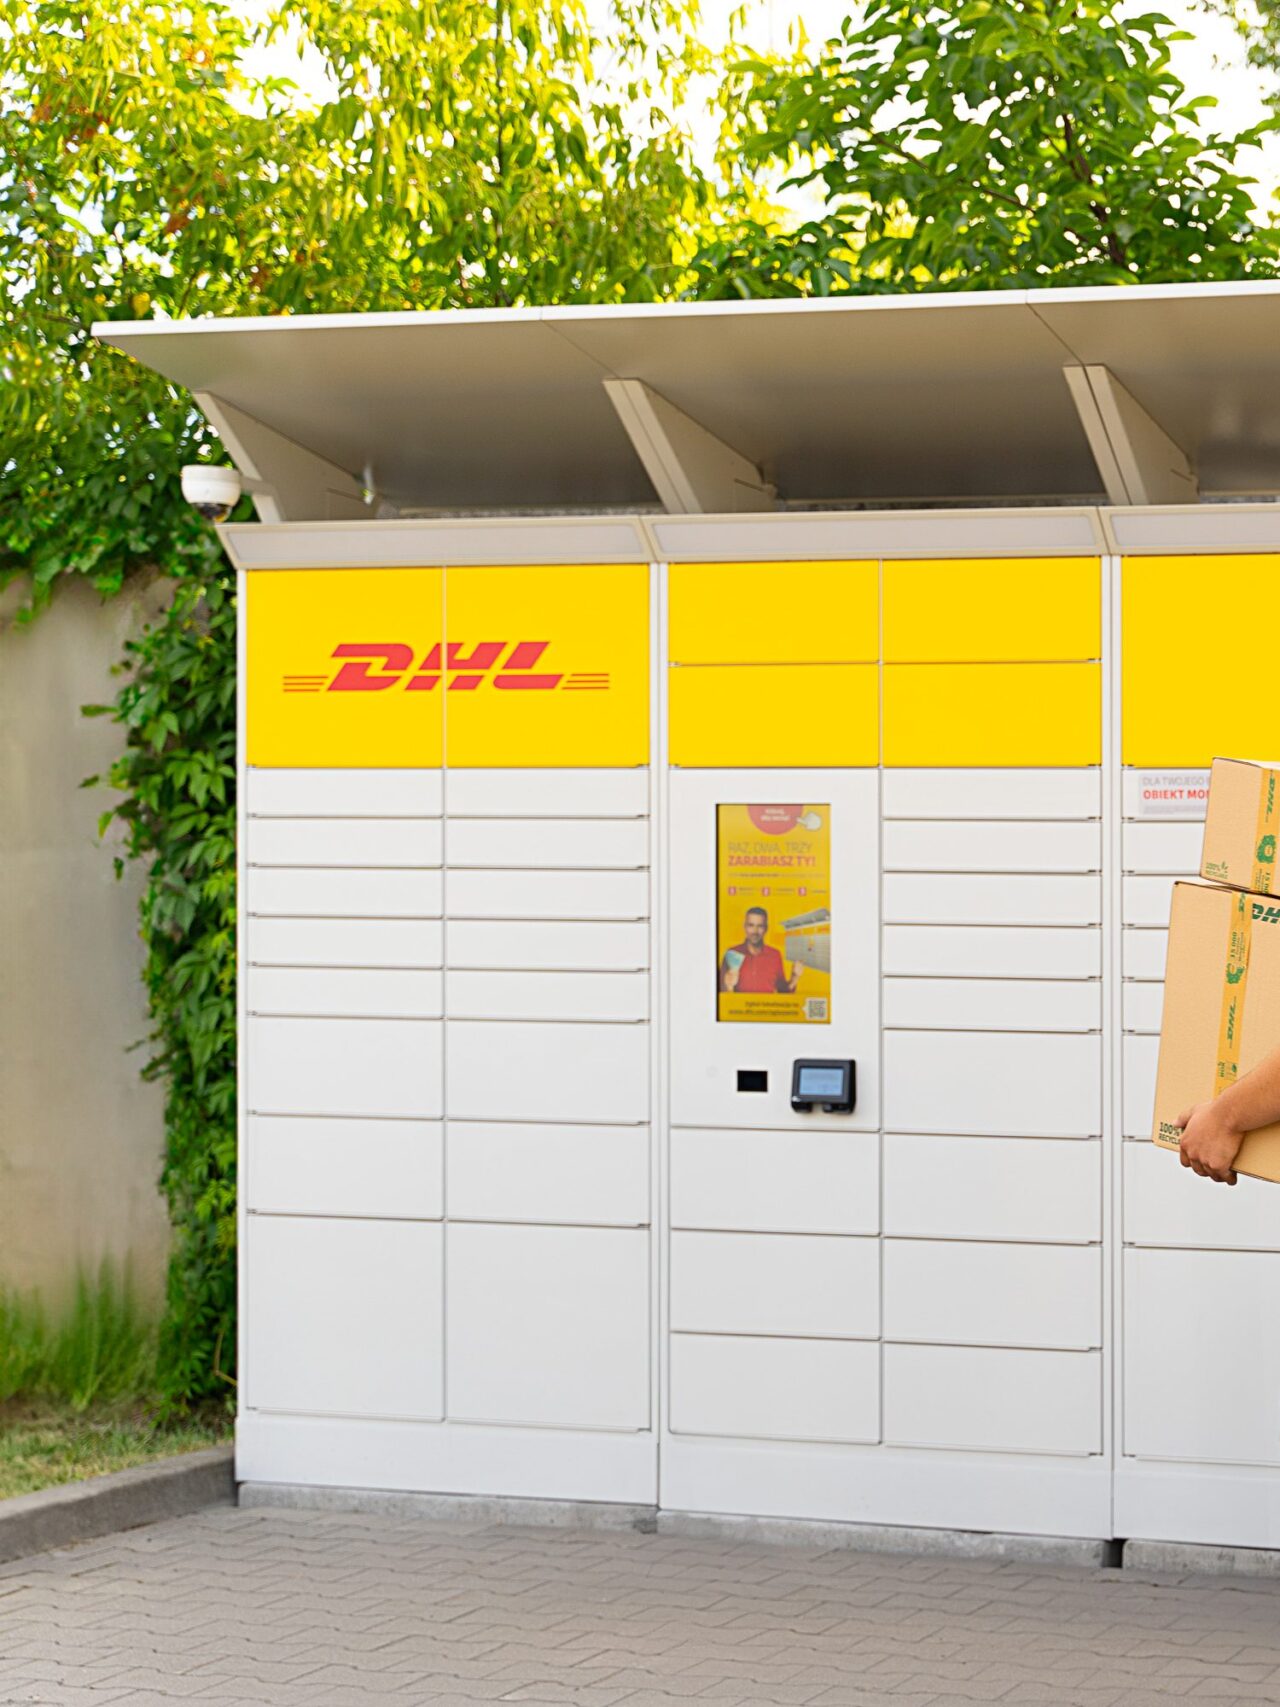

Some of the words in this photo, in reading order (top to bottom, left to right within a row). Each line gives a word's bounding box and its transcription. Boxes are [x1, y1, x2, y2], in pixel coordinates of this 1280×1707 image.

[326, 641, 564, 691] DHL
[1143, 790, 1184, 800] OBIEKT
[728, 855, 794, 867] ZARABIASZ
[797, 855, 816, 867] TY!
[1227, 1004, 1235, 1040] DHL
